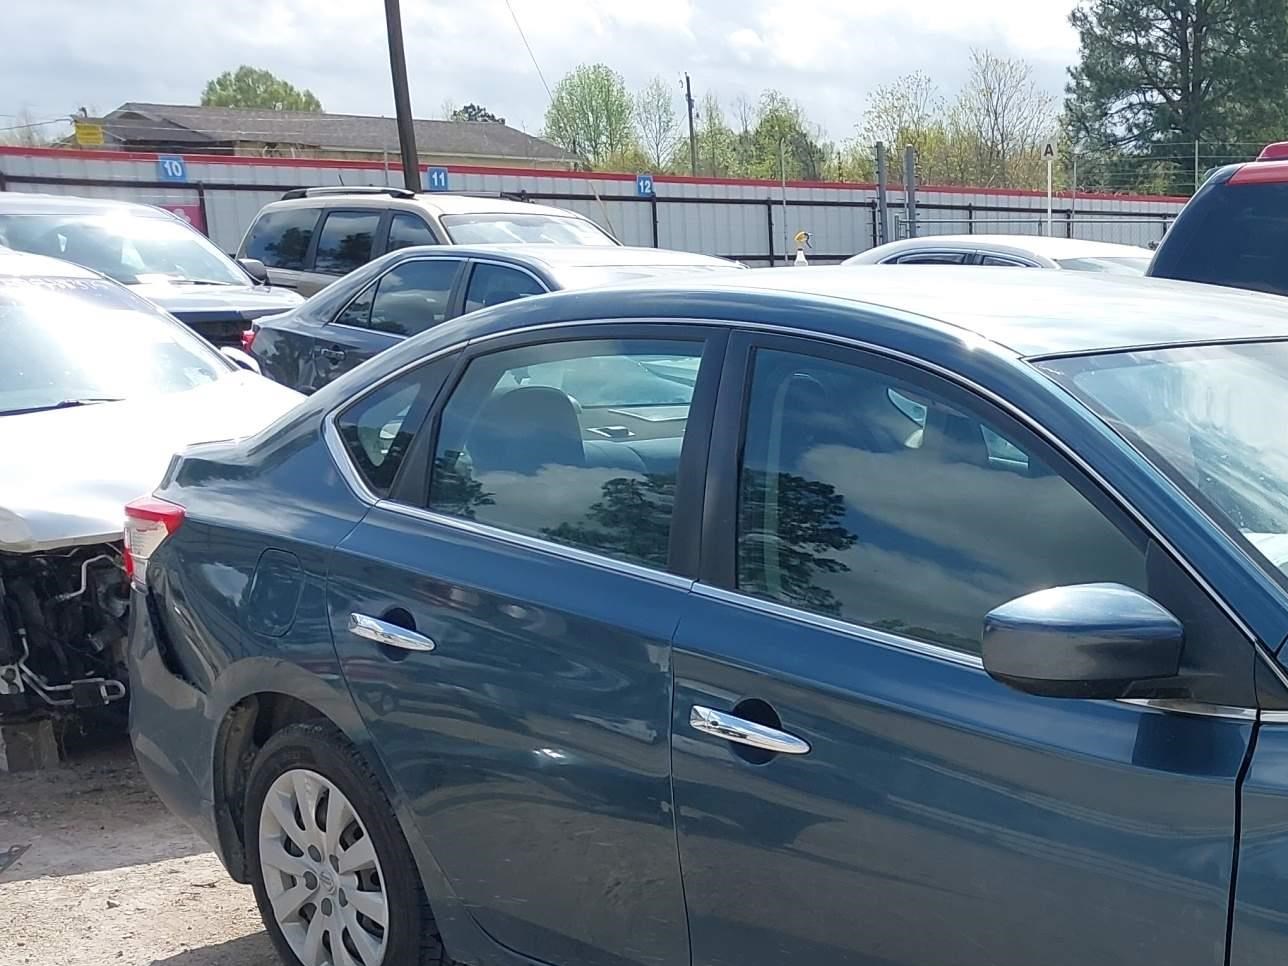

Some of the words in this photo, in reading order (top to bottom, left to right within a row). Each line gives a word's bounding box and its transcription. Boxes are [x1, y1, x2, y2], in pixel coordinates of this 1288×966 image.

[1043, 143, 1054, 156] A
[164, 160, 182, 177] 10
[432, 171, 445, 187] 11
[639, 180, 652, 193] 12
